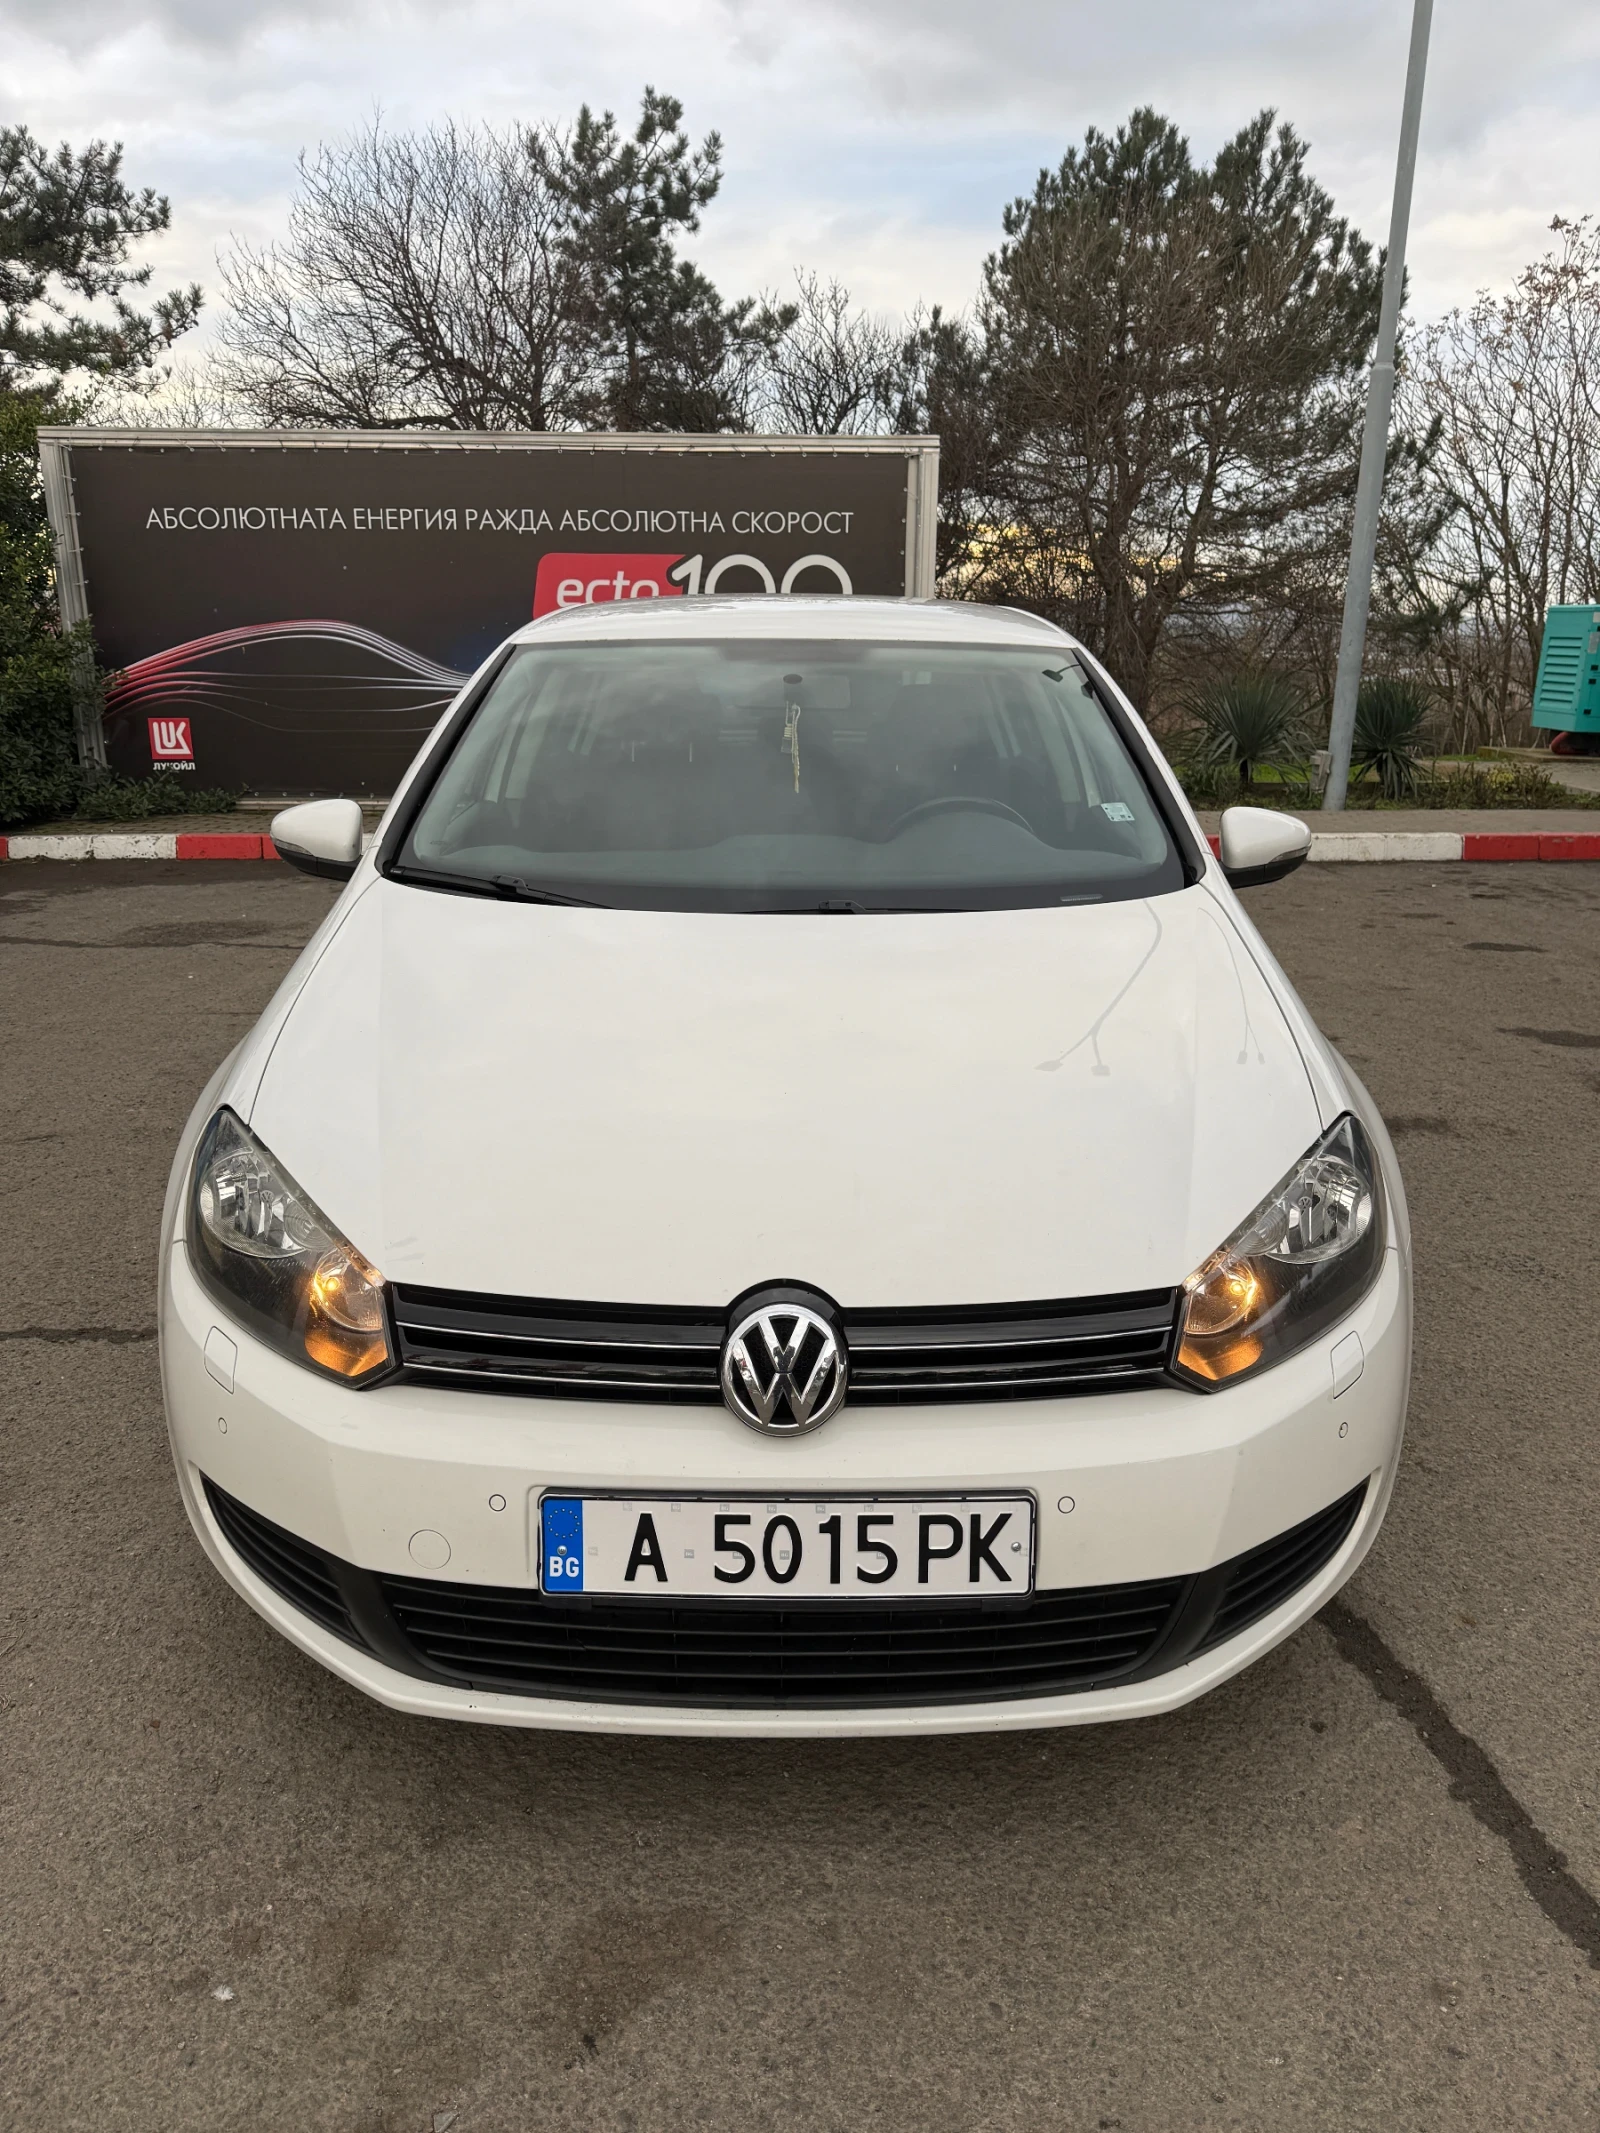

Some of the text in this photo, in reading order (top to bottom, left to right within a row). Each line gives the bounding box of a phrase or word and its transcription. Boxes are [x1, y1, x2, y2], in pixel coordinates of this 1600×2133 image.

[146, 507, 854, 535] АБСОЛЮТНАТА ЕНЕРГИЯ РАЖДА АБСОЛЮТНА СКОРОСТ
[549, 1556, 580, 1578] BG
[624, 1513, 669, 1583] A
